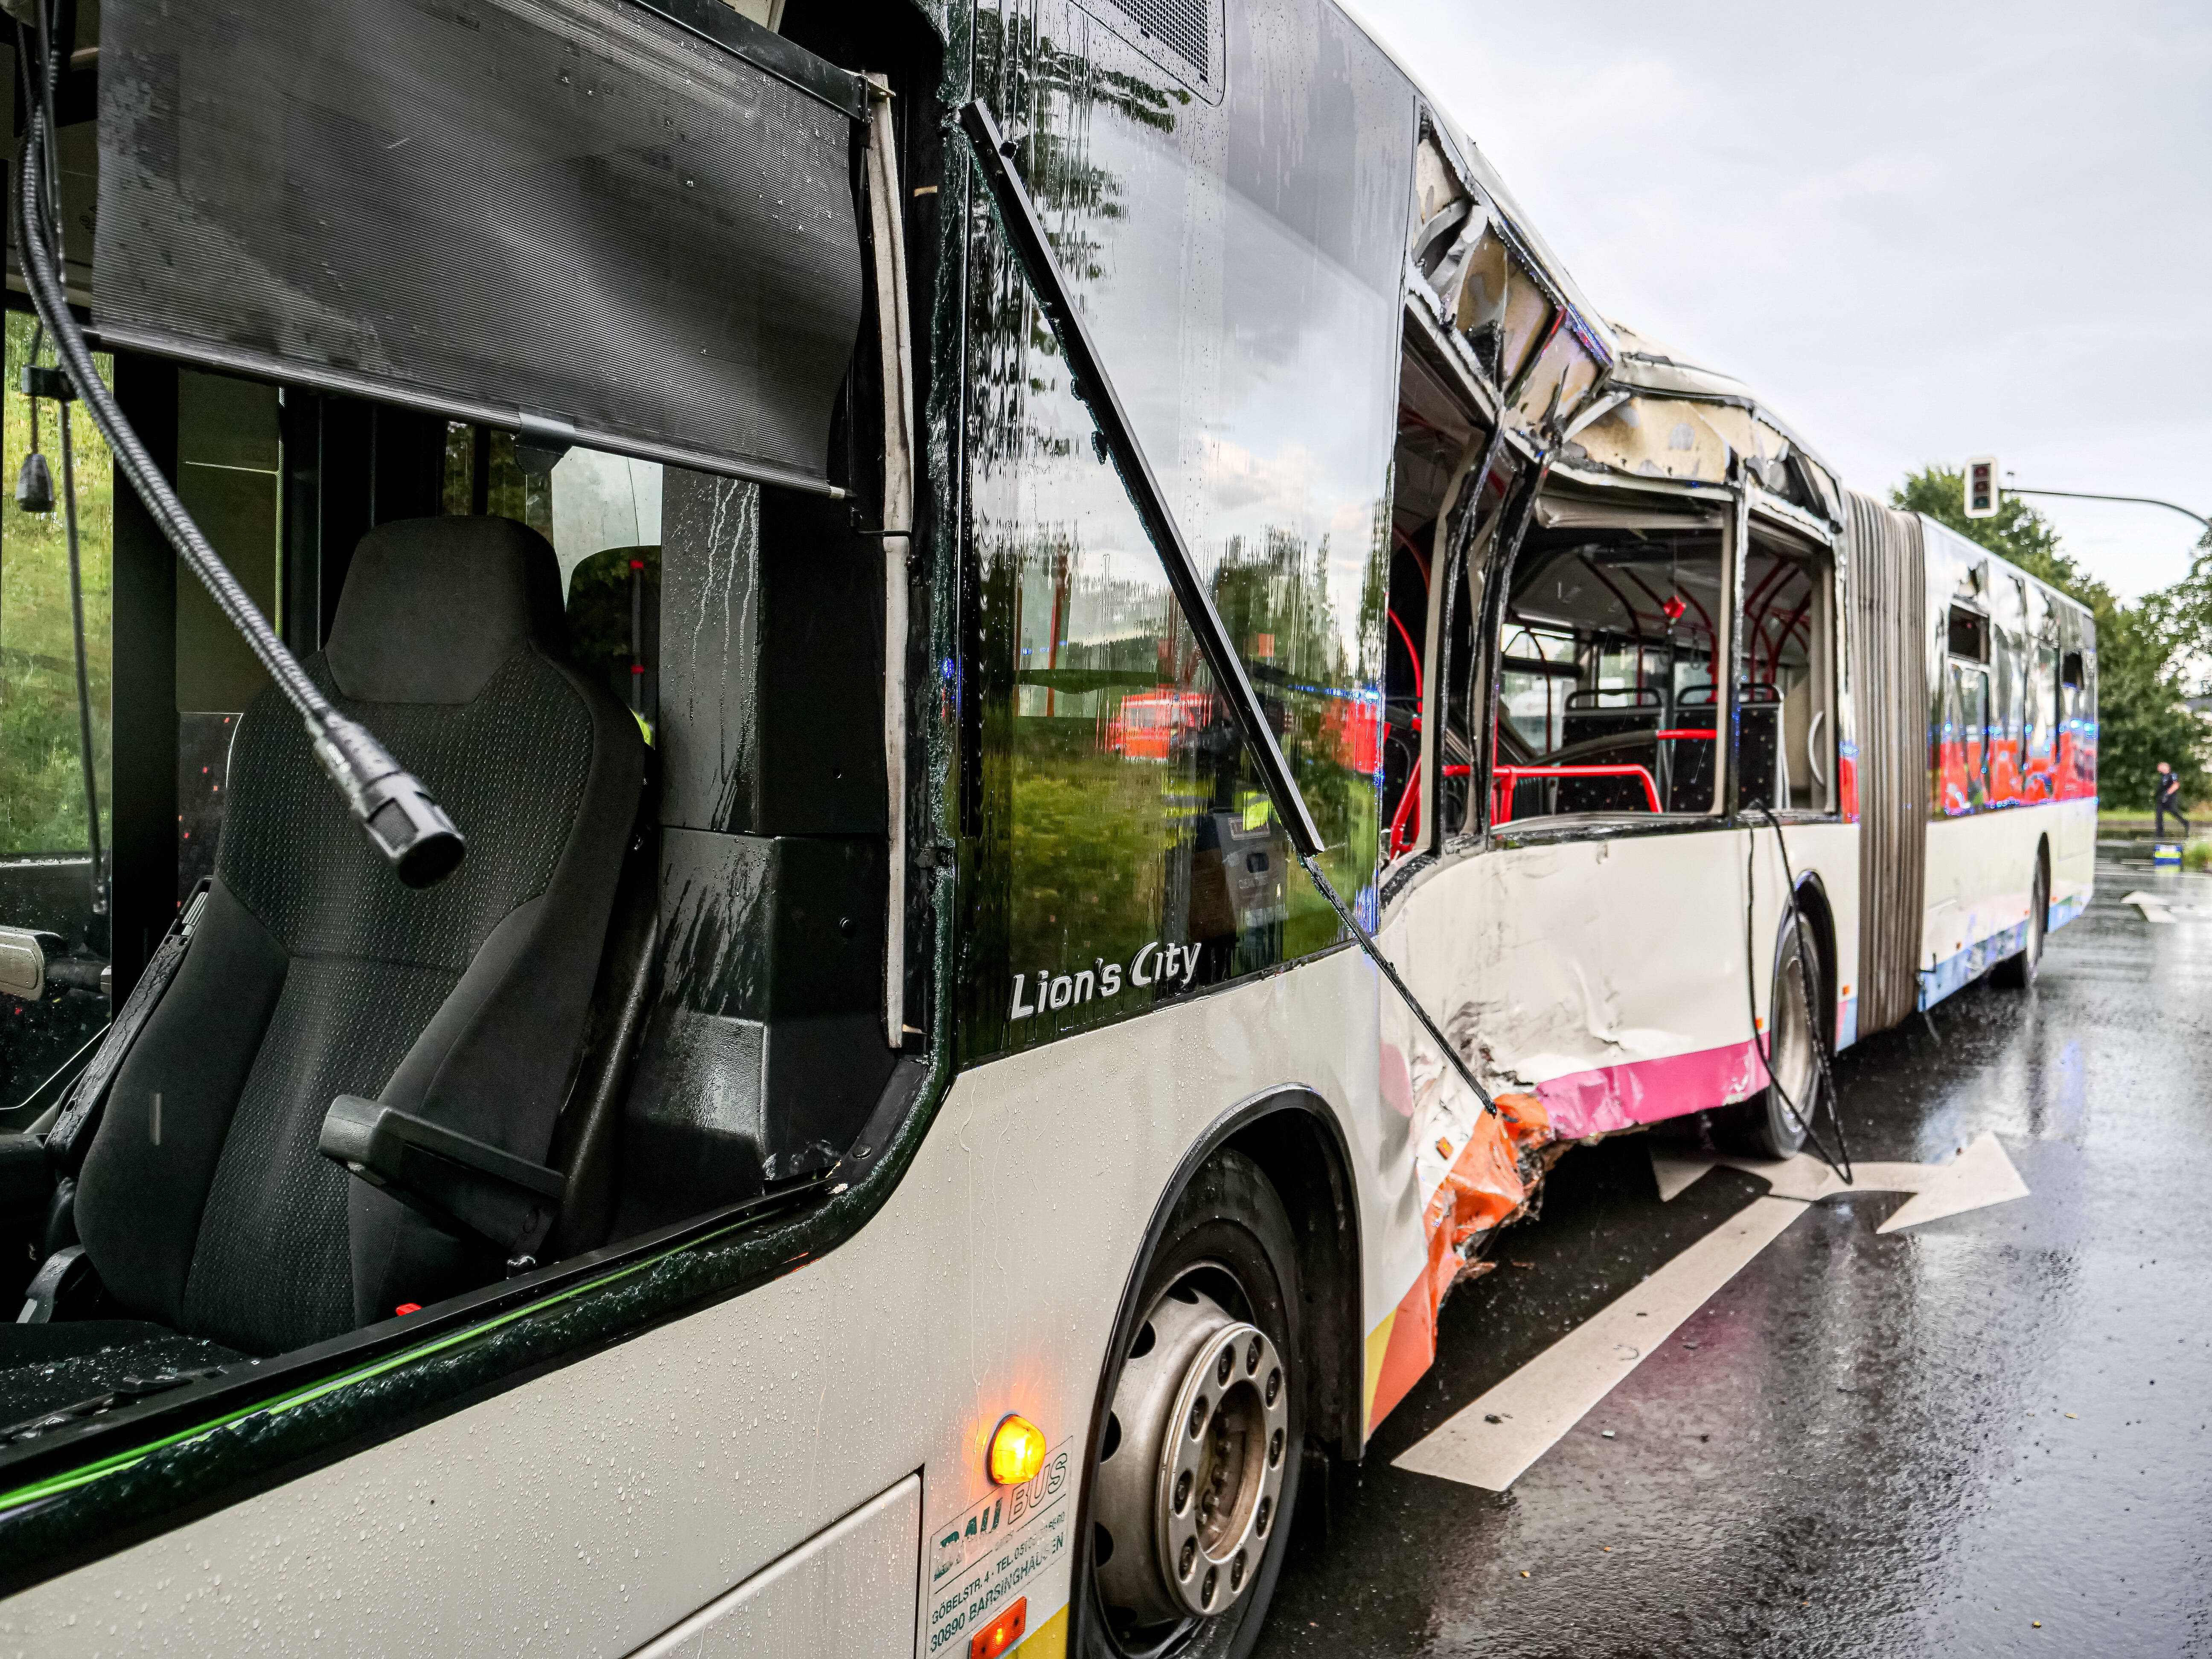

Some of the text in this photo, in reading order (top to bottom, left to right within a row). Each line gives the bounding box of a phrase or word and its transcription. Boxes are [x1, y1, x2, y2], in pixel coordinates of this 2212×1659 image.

[1010, 941, 1202, 1021] Lion's City
[1007, 1452, 1068, 1525] BUS
[930, 1612, 966, 1653] 30890
[968, 1531, 1064, 1623] BARSINGHAUEN
[932, 1577, 983, 1625] GÖBELSTR.
[984, 1570, 990, 1583] 4
